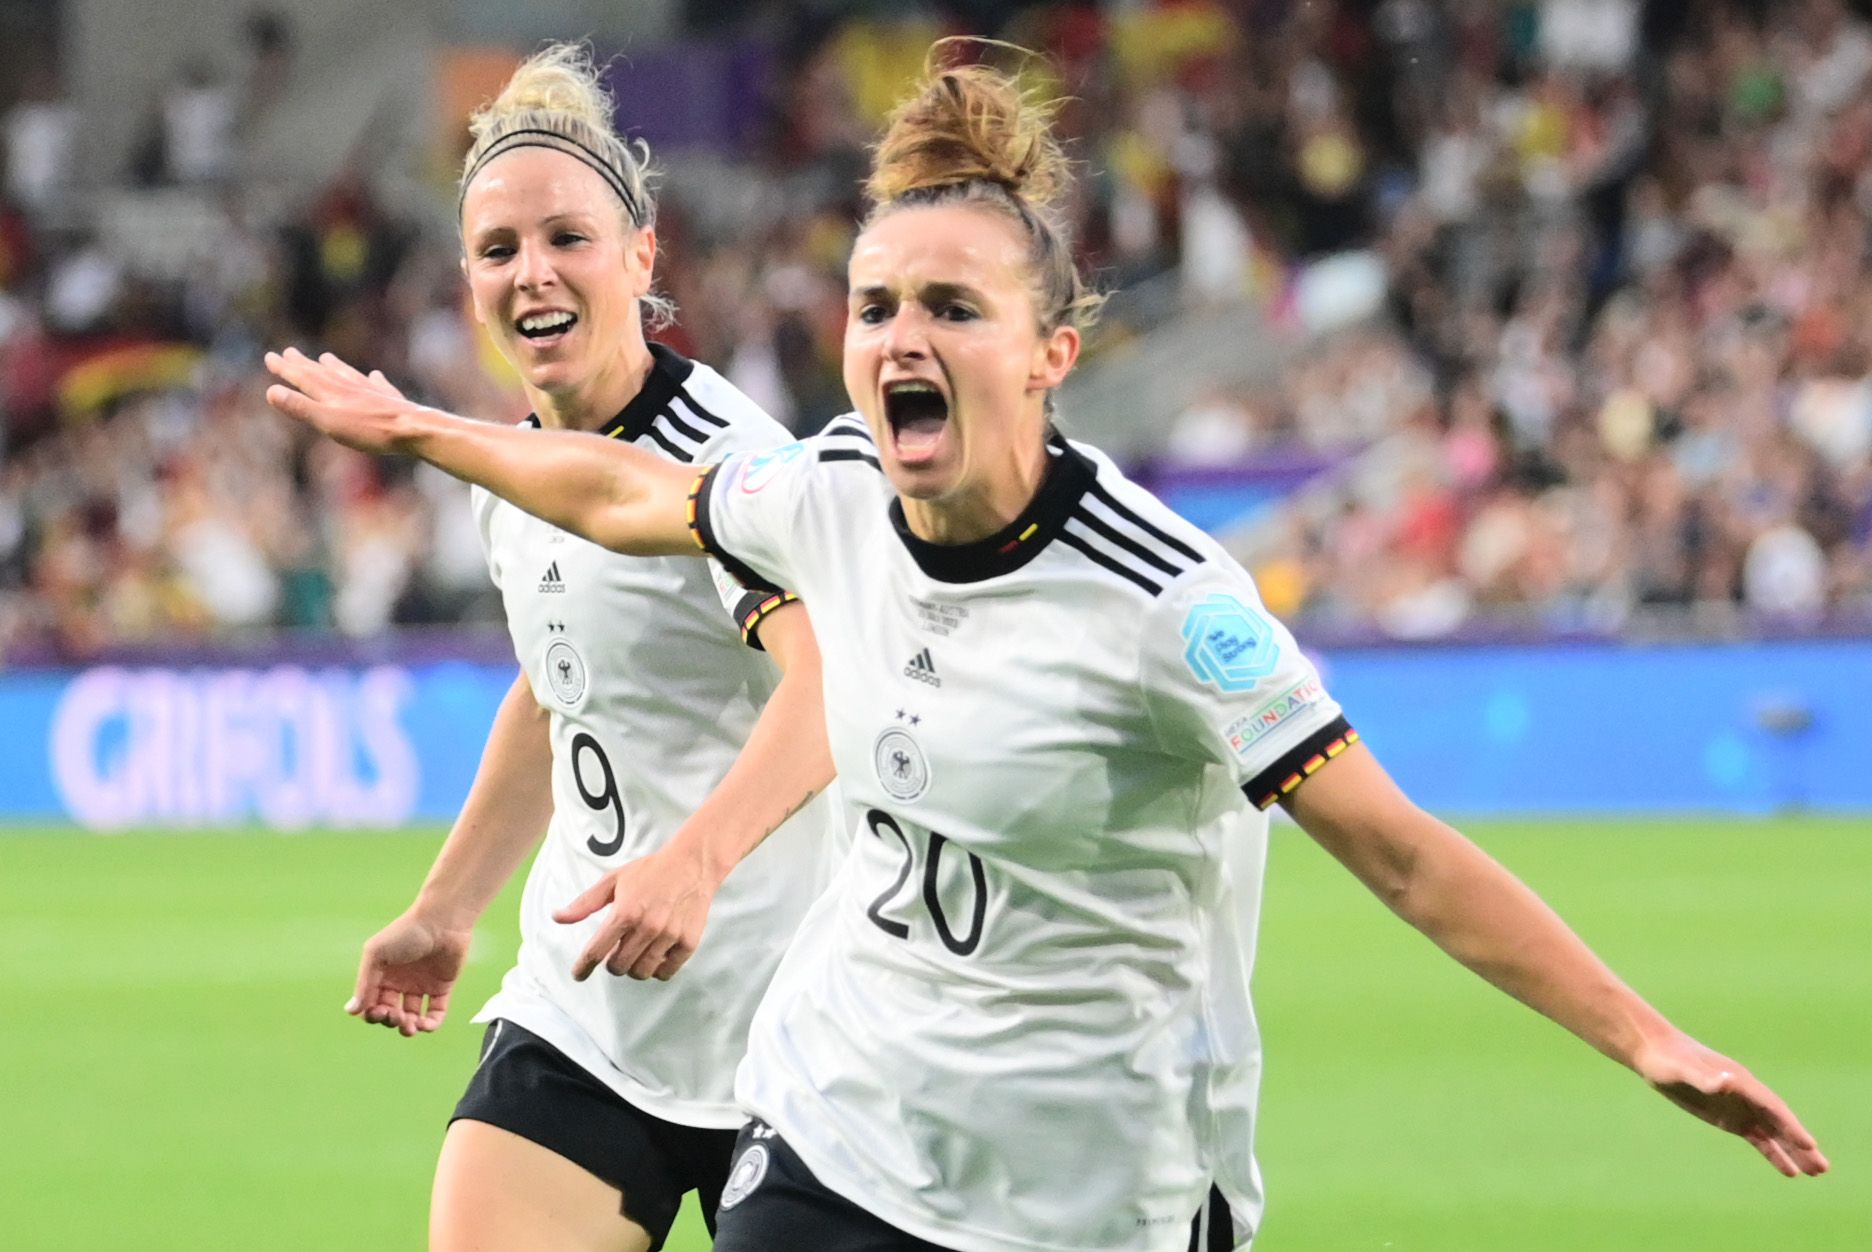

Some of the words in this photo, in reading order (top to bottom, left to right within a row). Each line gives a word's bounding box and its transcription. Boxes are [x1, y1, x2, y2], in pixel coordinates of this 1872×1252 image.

[904, 666, 941, 688] adidas
[1231, 679, 1319, 751] FOUNDATIO
[571, 732, 626, 857] 9
[866, 808, 988, 957] 20
